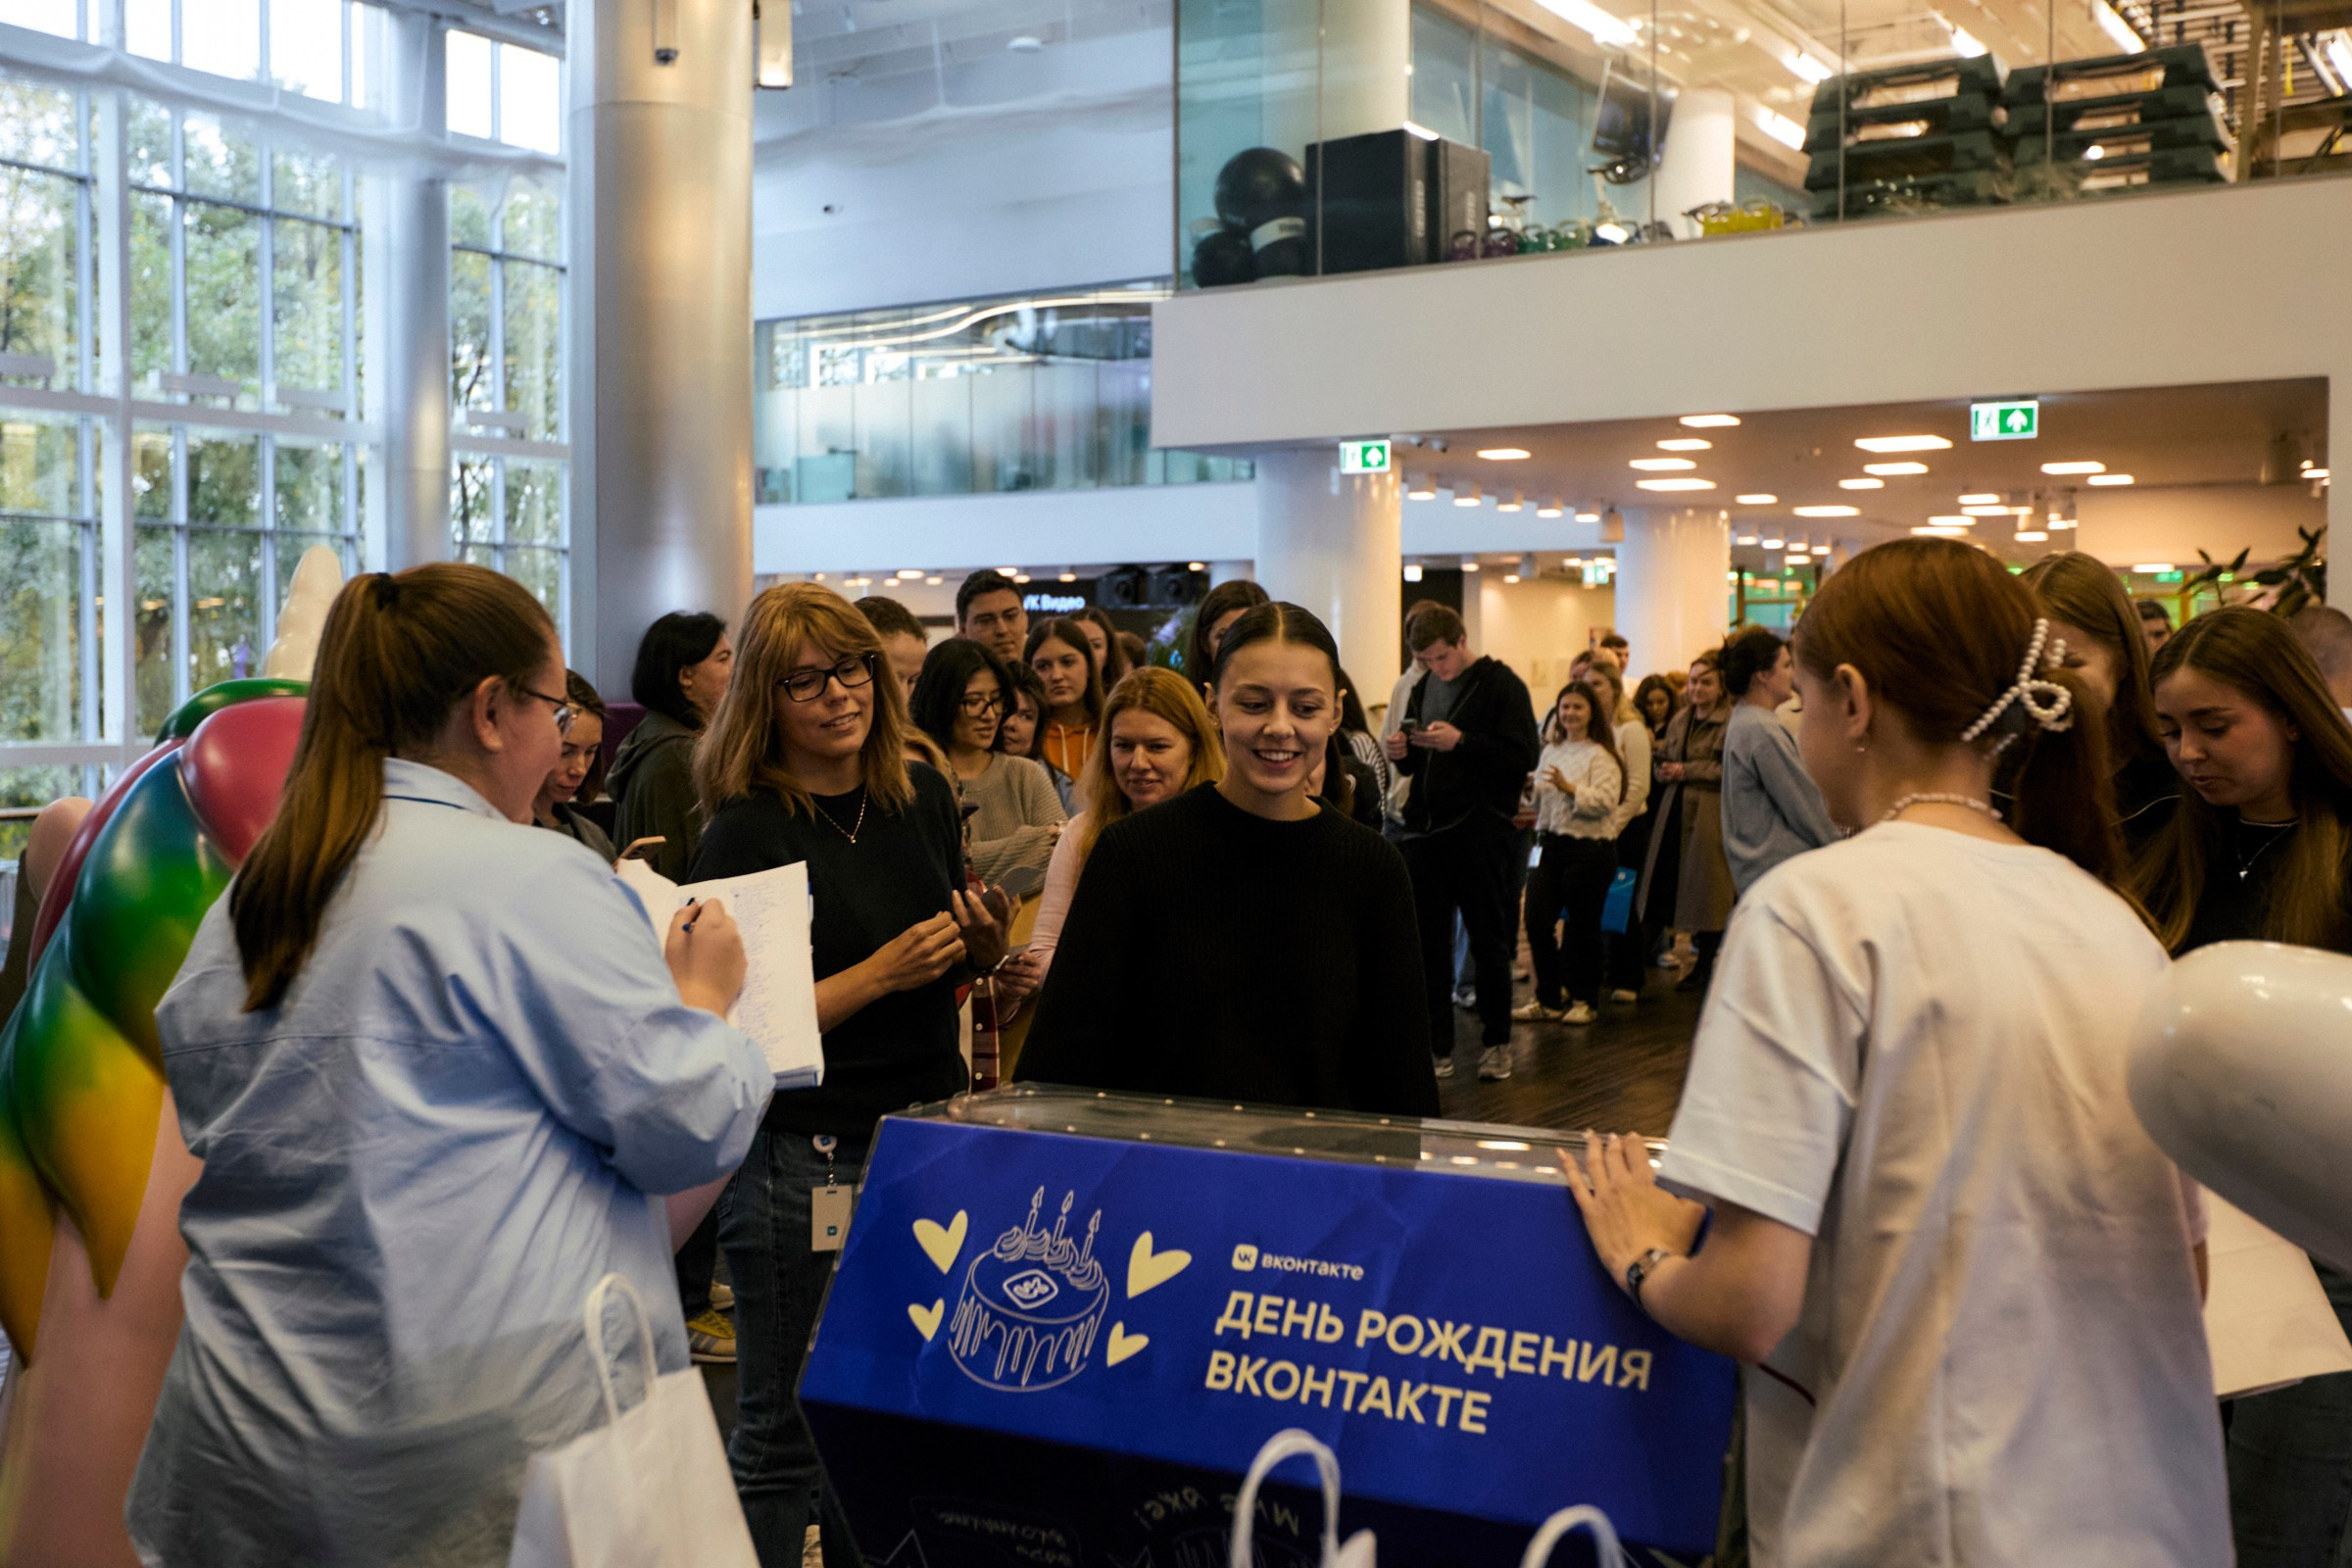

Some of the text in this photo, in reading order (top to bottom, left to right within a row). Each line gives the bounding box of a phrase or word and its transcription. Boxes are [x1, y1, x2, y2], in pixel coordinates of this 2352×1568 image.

[1041, 594, 1086, 612] Видео
[1214, 1291, 1651, 1390] ДЕНЬ РОЖДЕНИЯ
[1204, 1350, 1492, 1434] ВКОНТАКТЕ
